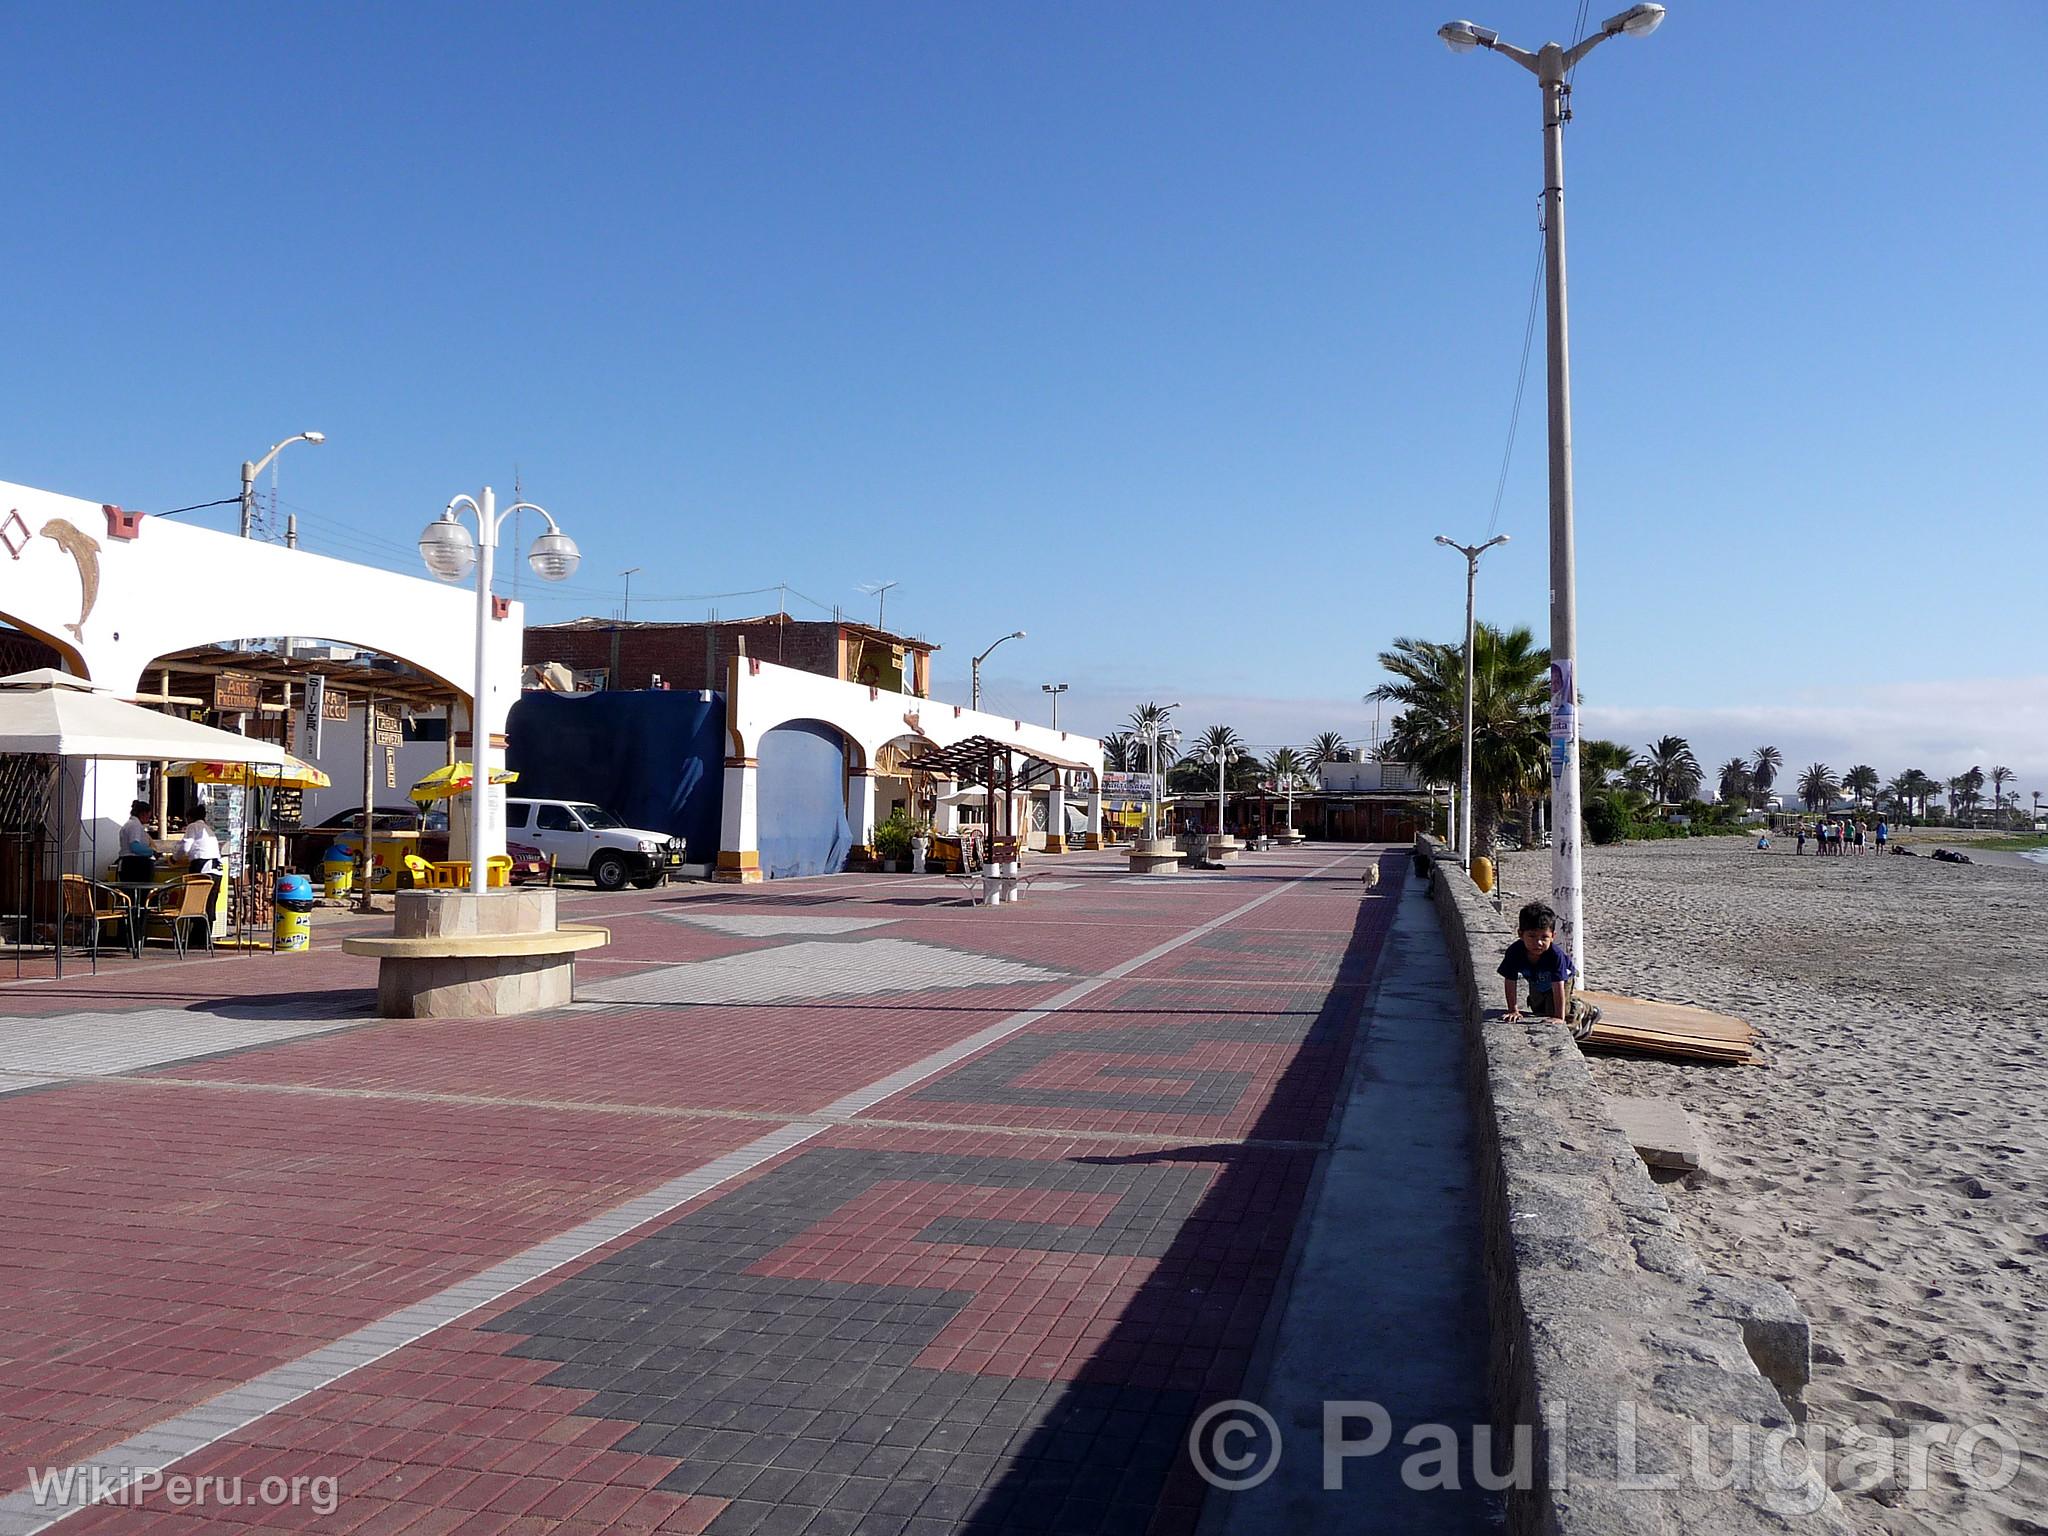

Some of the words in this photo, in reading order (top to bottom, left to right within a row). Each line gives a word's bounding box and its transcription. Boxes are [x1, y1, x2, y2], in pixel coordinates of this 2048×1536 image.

[227, 680, 250, 695] ARTE
[306, 678, 319, 731] SILVER
[324, 691, 337, 704] KA
